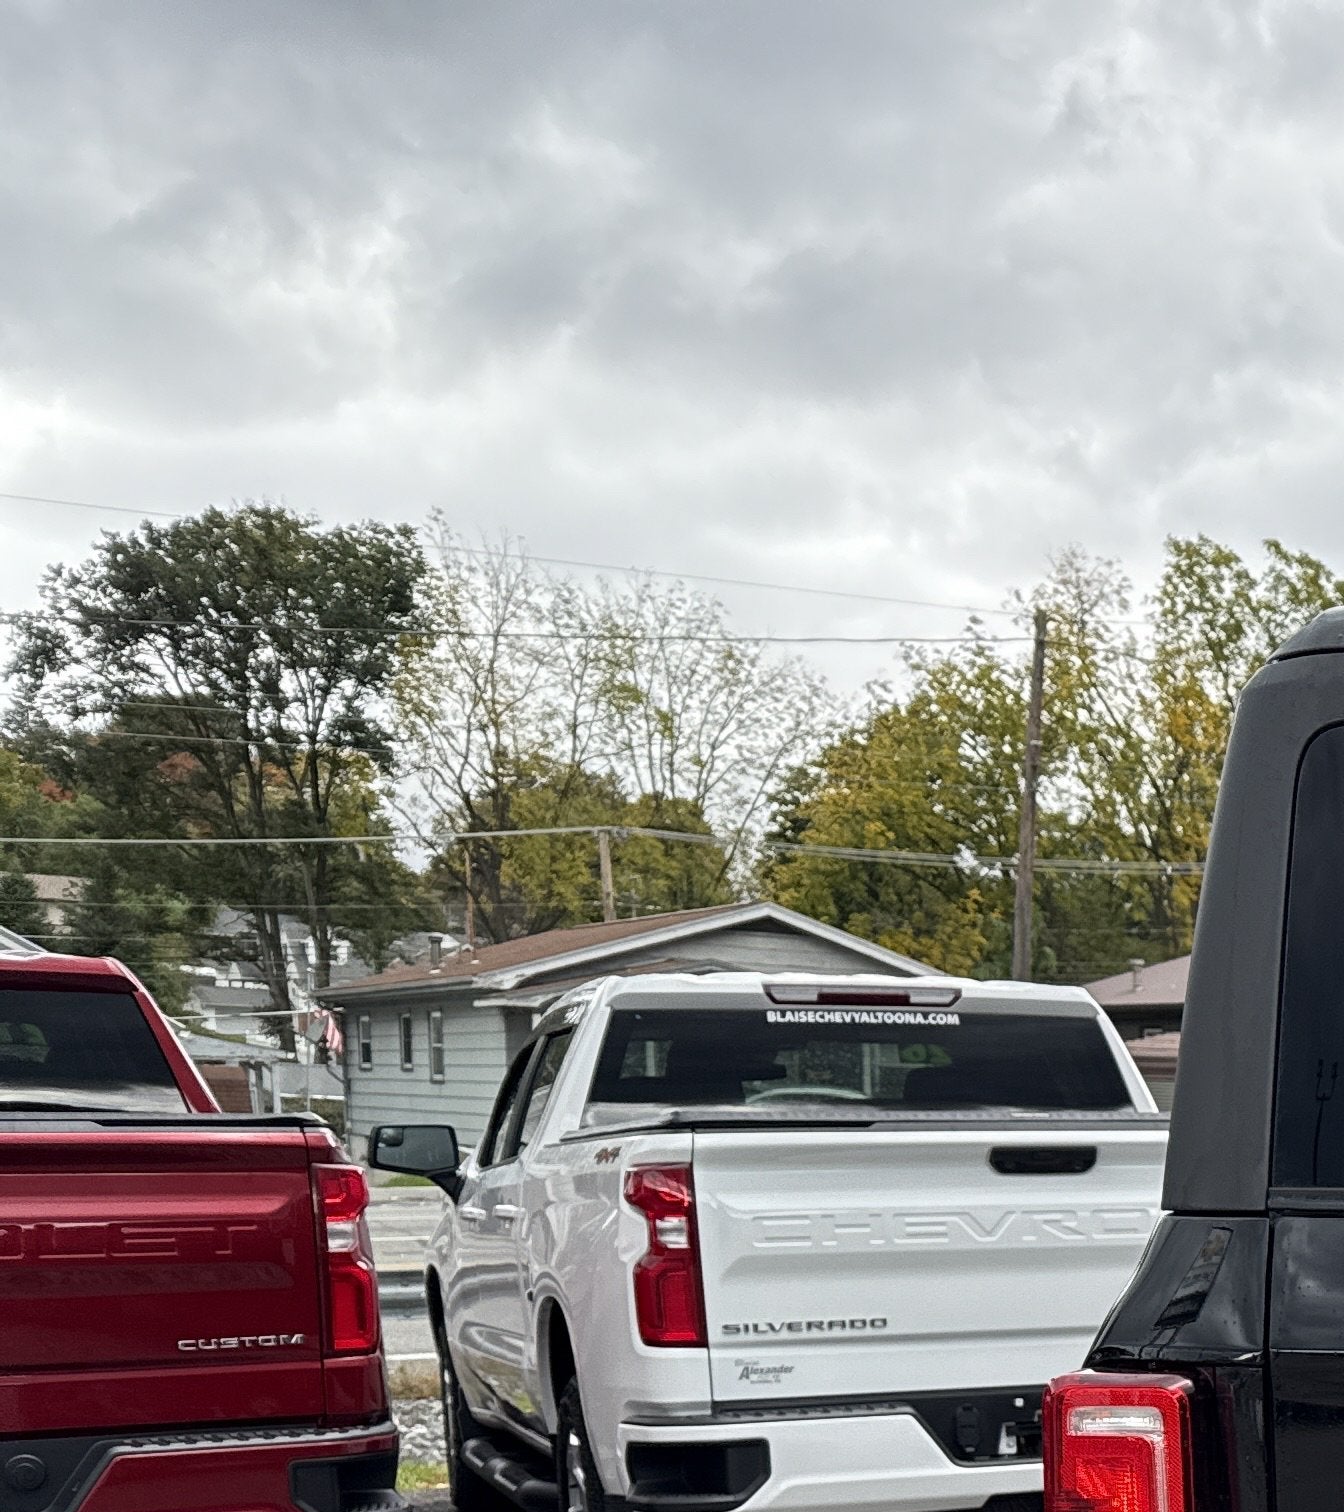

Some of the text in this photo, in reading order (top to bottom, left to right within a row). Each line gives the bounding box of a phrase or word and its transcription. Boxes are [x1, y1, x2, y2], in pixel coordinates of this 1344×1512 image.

[765, 1010, 961, 1026] BLAISECHEVYALTOONA.COM
[750, 1208, 1153, 1248] CHEVRO
[721, 1318, 888, 1335] SILVERADO
[177, 1334, 305, 1351] CUSTOM
